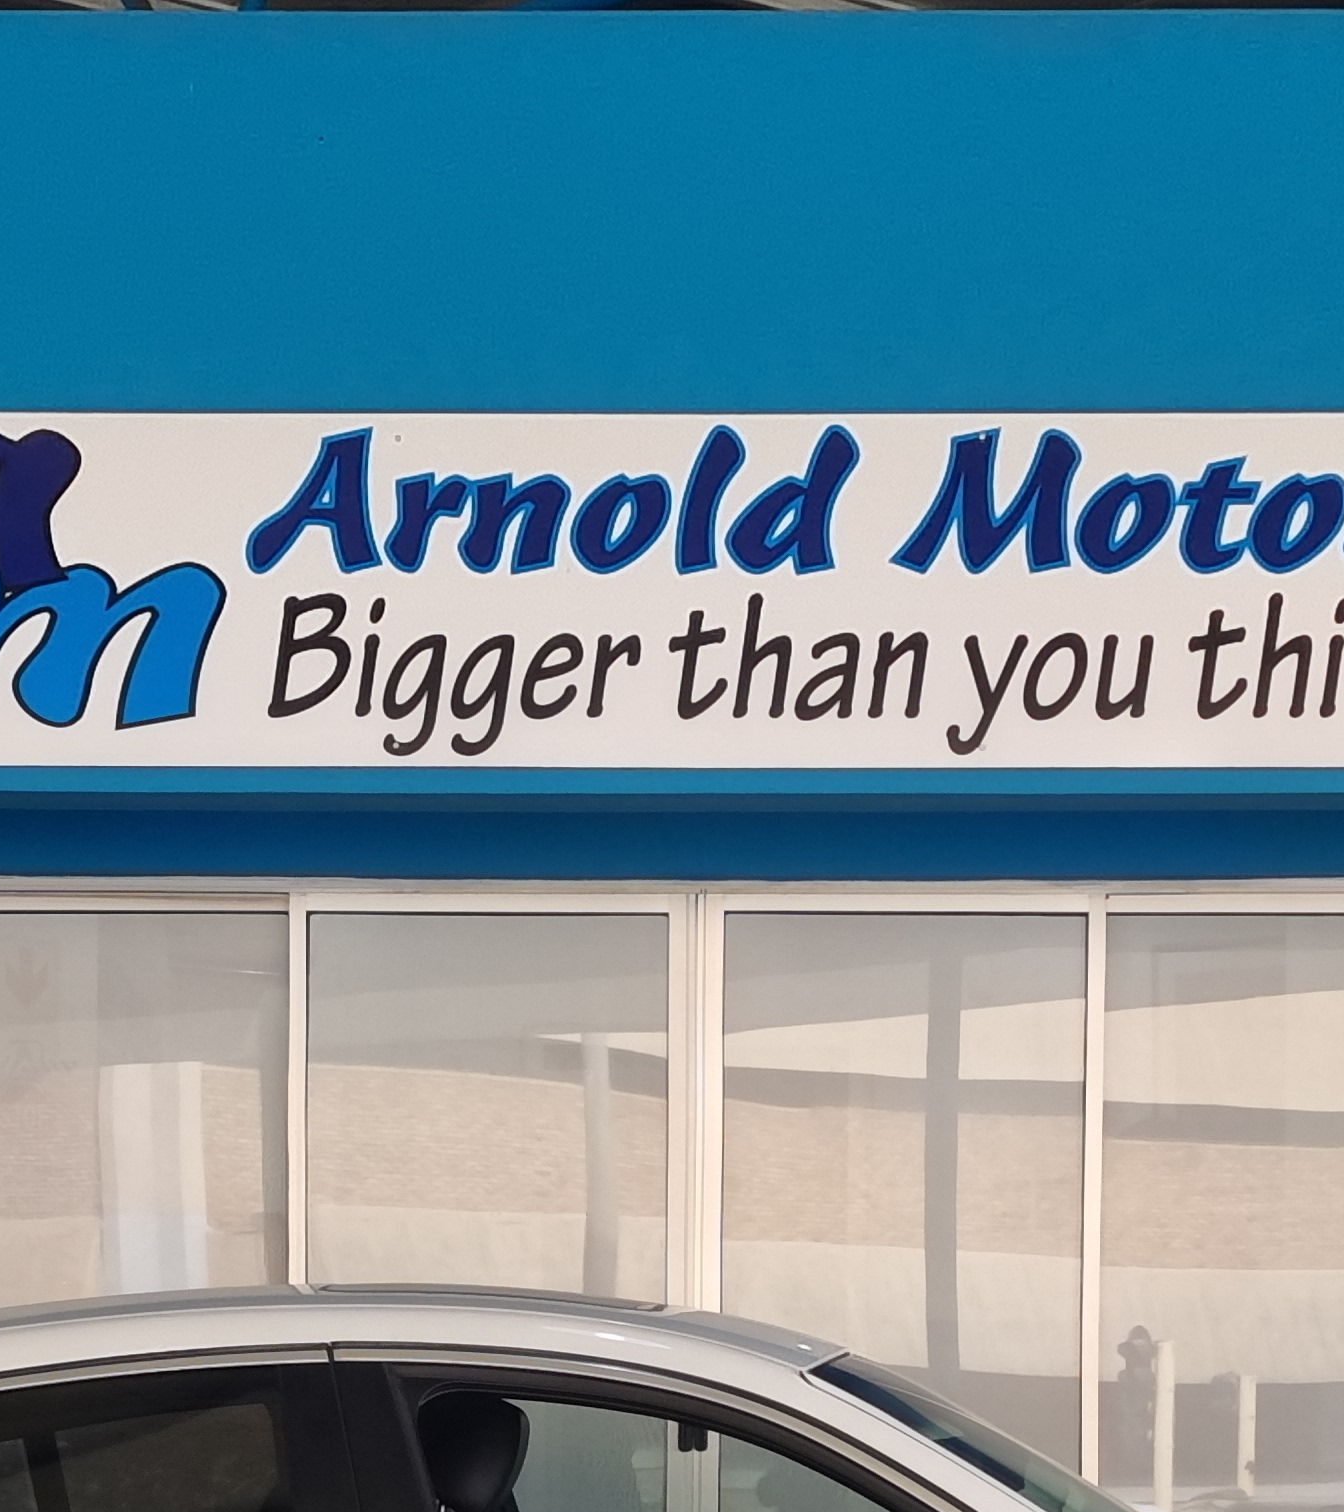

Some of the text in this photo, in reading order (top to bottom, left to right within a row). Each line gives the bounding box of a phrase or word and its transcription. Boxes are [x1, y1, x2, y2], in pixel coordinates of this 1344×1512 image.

[246, 425, 861, 576] Arnold
[267, 593, 641, 757] Bigger
[668, 592, 929, 722] than
[946, 632, 1155, 756] you
